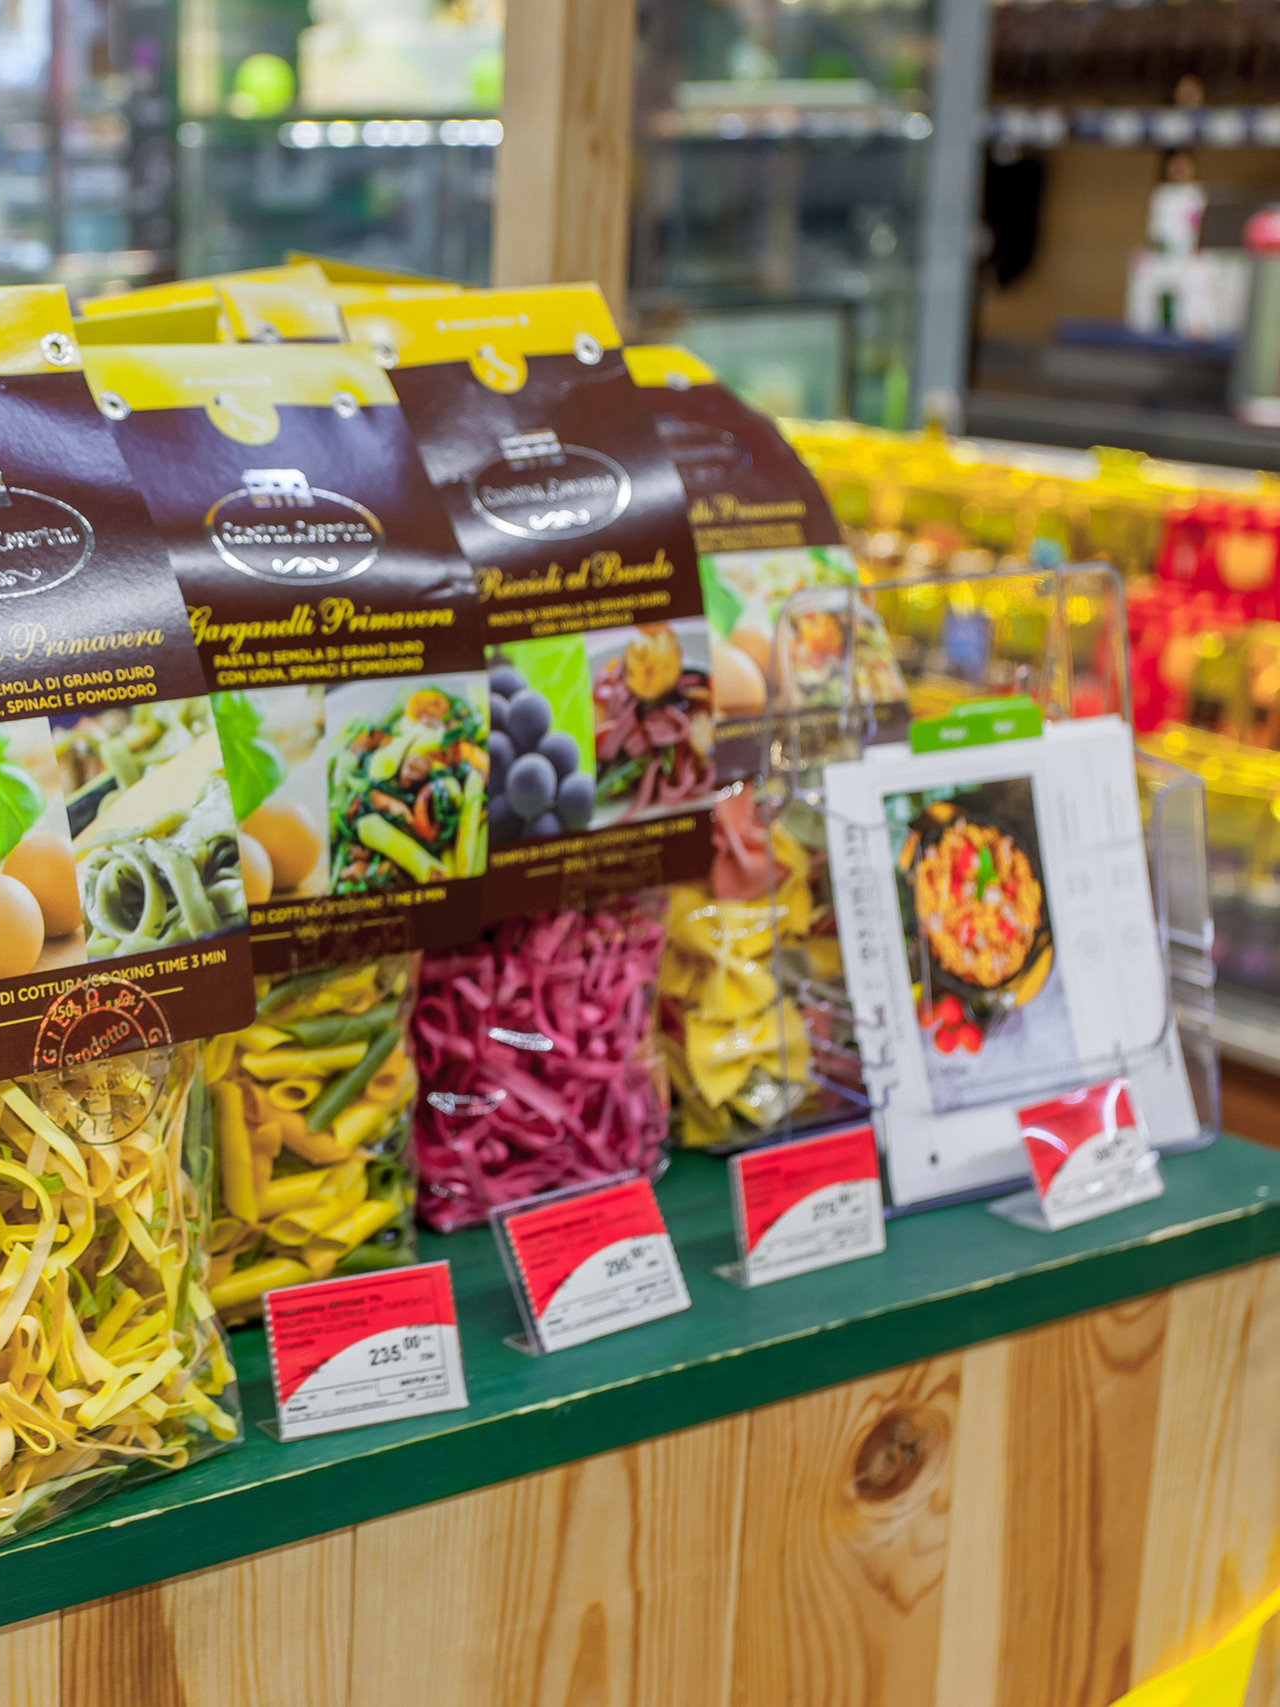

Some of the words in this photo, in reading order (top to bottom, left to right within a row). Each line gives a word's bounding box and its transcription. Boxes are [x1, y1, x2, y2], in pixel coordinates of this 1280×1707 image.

[8, 621, 165, 661] Primavera
[186, 603, 317, 653] Garganelli
[318, 597, 456, 635] Primavera
[214, 652, 255, 668] PASTA
[46, 675, 60, 691] DI
[63, 669, 113, 688] GRANO
[115, 664, 155, 682] DURO
[217, 669, 247, 685] CON
[8, 695, 62, 714] SPINACI
[64, 693, 74, 707] E
[77, 682, 157, 704] POMODORO
[0, 991, 15, 1004] DI
[156, 957, 189, 975] TIME
[191, 956, 200, 969] 3
[201, 949, 227, 966] MIN
